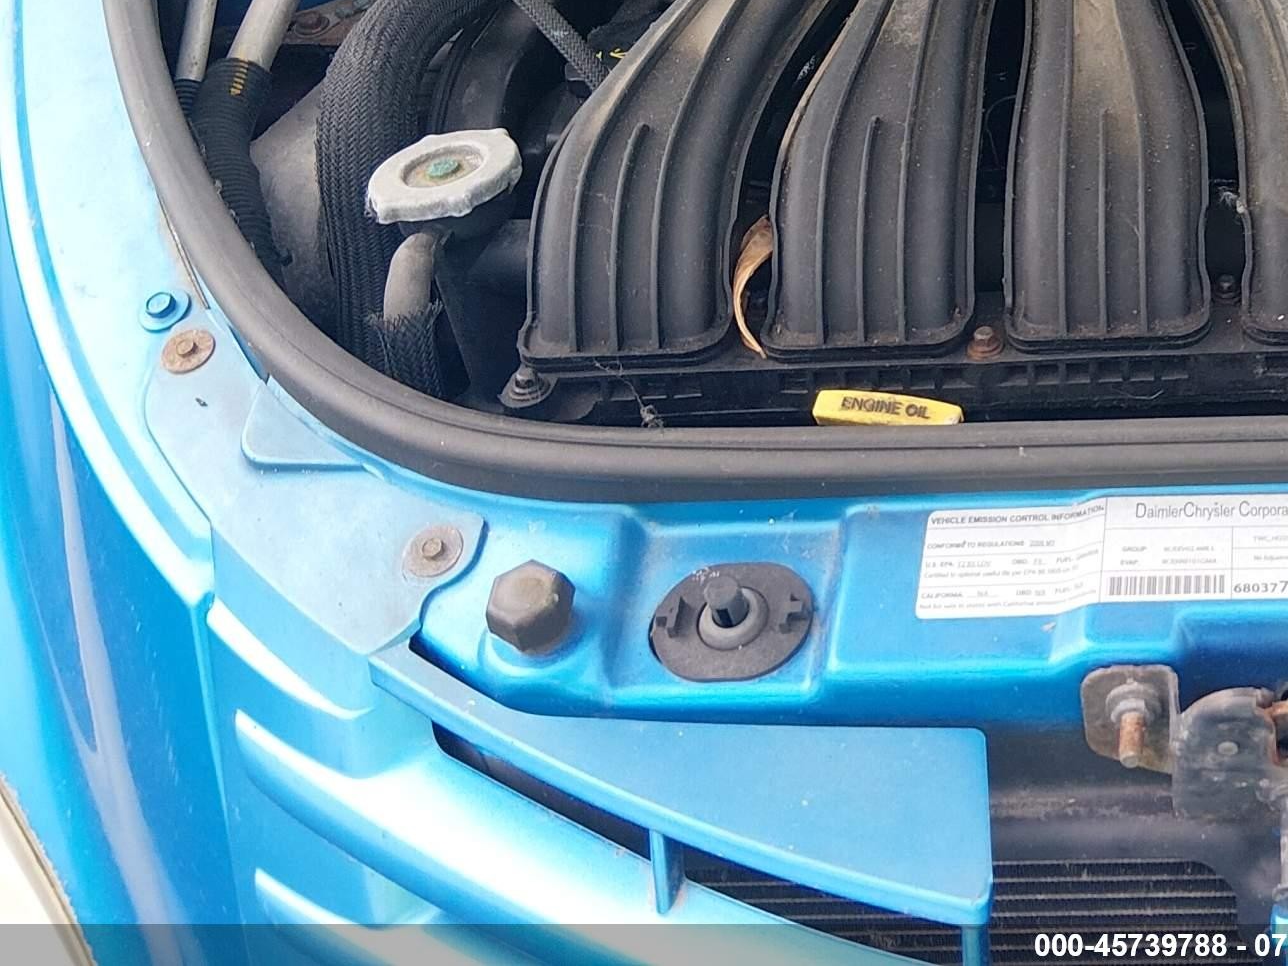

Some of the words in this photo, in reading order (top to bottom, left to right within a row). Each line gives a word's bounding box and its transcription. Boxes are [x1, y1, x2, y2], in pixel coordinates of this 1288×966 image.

[841, 396, 902, 415] ENGINE
[905, 403, 931, 420] OIL
[931, 517, 966, 525] VEHICLE
[968, 514, 1008, 524] EMISSION
[1009, 513, 1049, 523] CONTROL
[1051, 506, 1105, 521] INFORMATION
[1135, 501, 1236, 521] DaimlerChrysler
